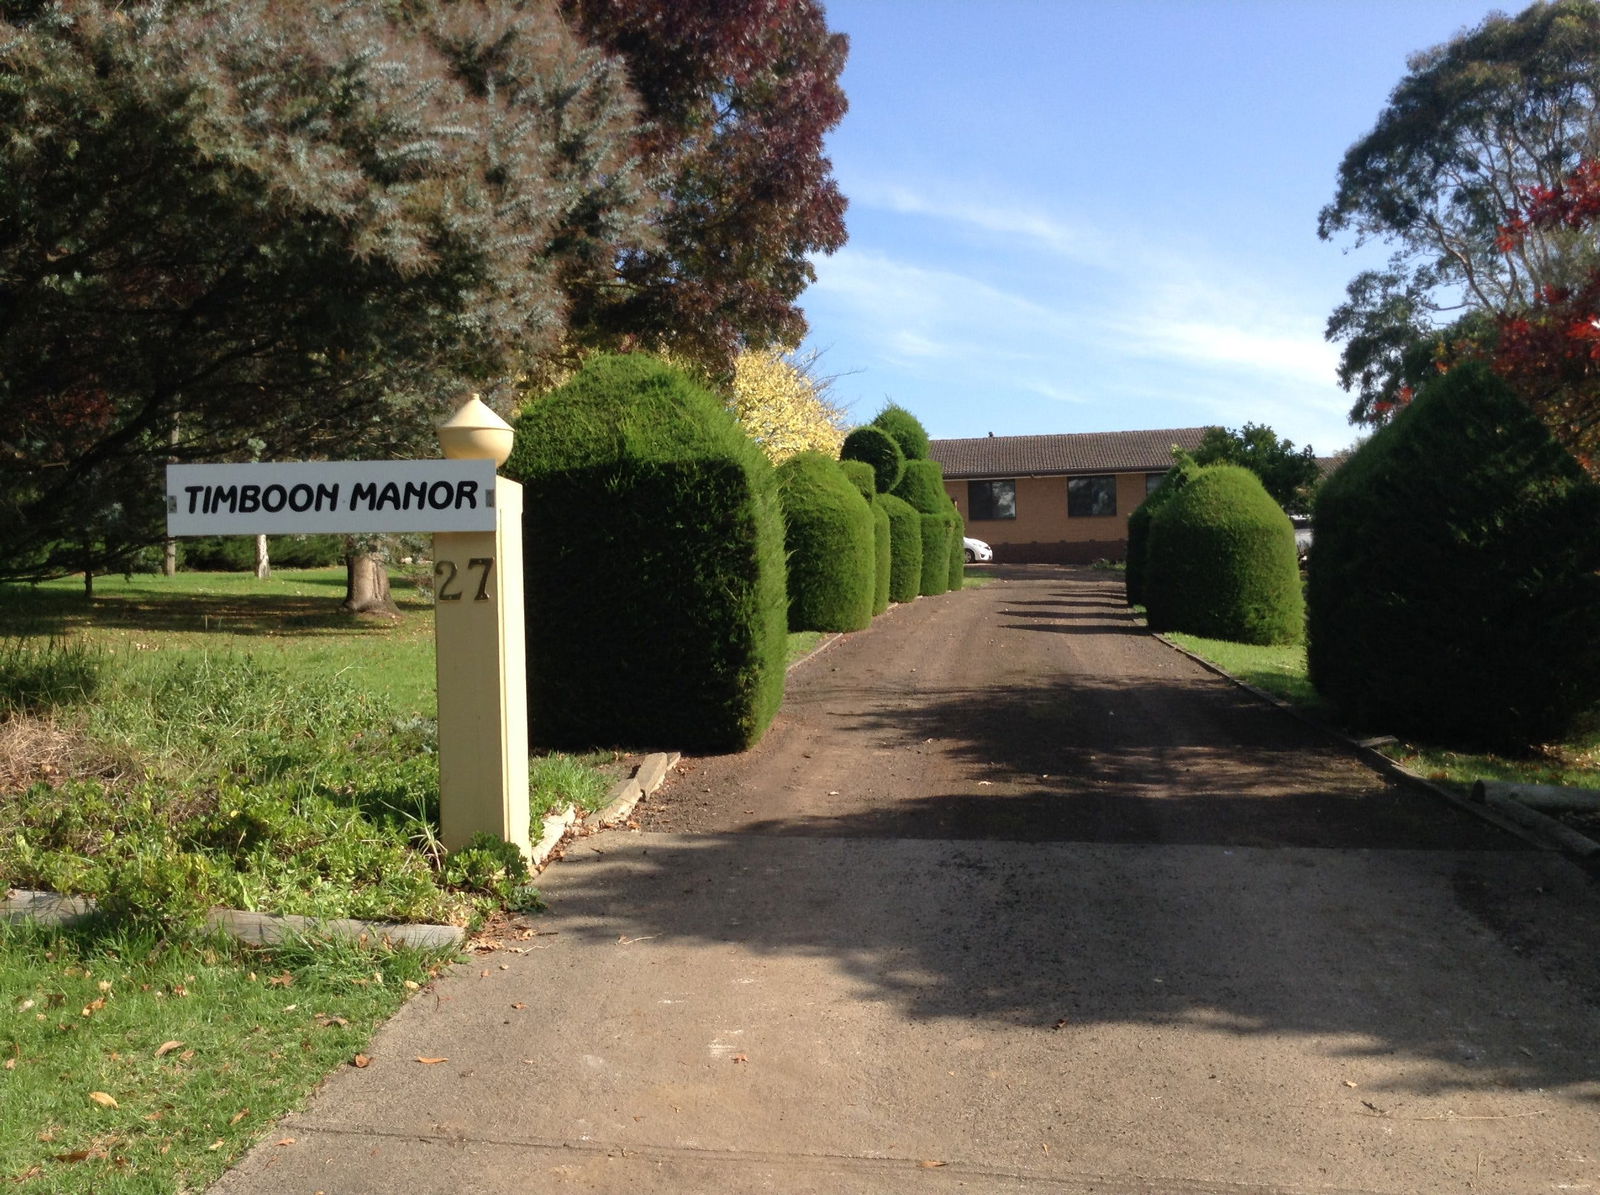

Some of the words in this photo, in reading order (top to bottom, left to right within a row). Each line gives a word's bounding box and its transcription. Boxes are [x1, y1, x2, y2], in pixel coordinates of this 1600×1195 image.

[185, 483, 339, 514] TIMBOON
[349, 480, 478, 511] MANOR
[435, 557, 495, 602] 27
